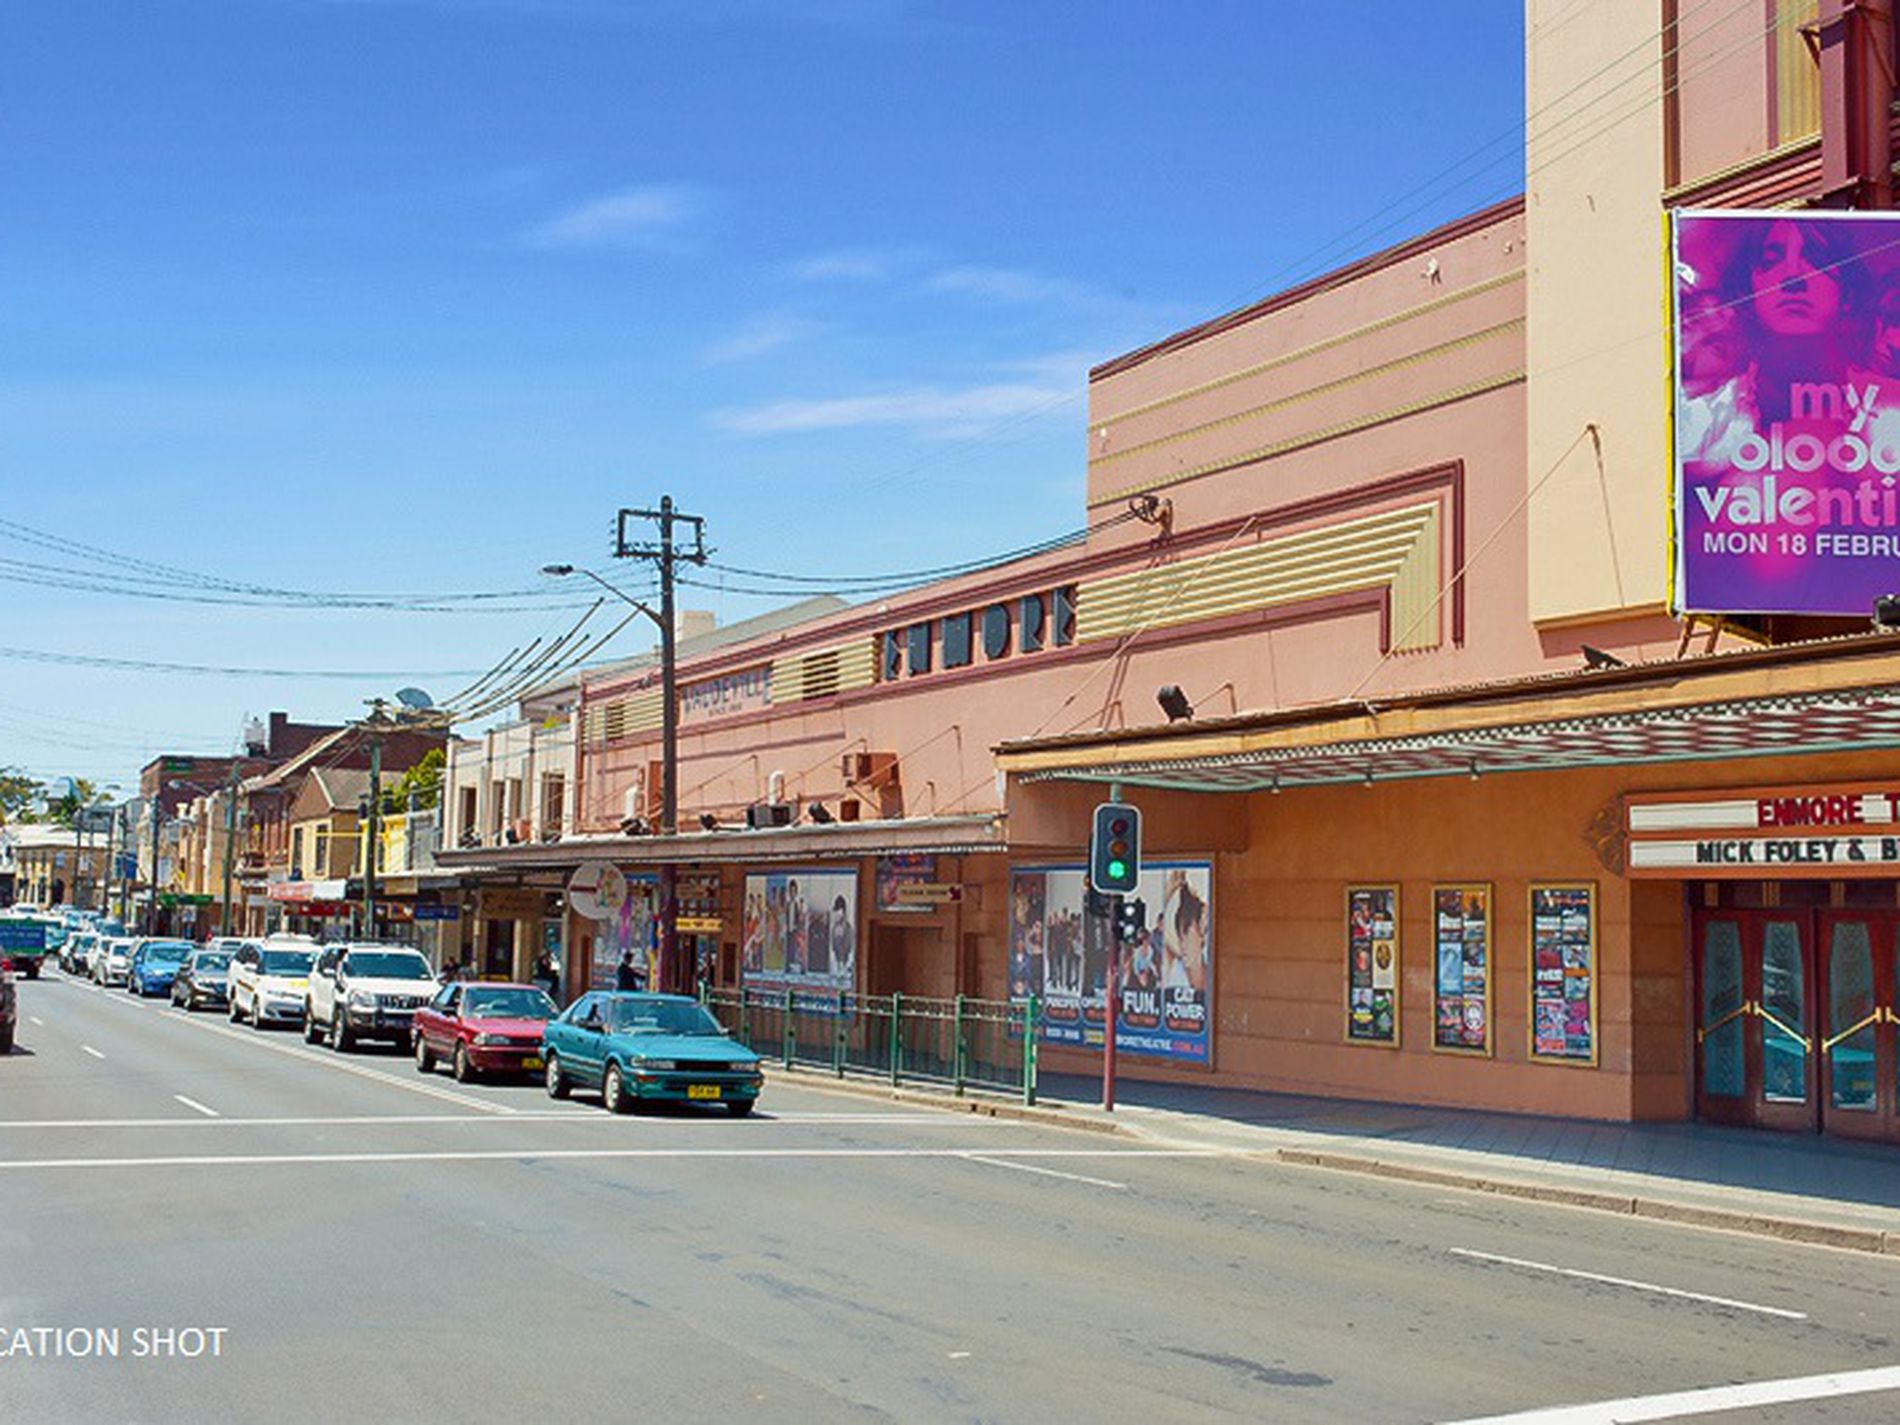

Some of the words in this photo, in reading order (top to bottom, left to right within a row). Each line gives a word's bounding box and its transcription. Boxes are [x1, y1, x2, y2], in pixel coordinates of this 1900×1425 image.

[1791, 383, 1880, 432] my
[1694, 474, 1897, 527] valenti
[1703, 532, 1768, 553] MON
[1776, 533, 1807, 555] 18
[1758, 794, 1864, 828] ENMORE
[1696, 840, 1754, 863] MICK
[1765, 839, 1838, 863] FOLEY
[1848, 838, 1866, 861] &
[1881, 837, 1900, 861] B
[1123, 991, 1160, 1015] FUN.
[1165, 1002, 1205, 1021] POWER
